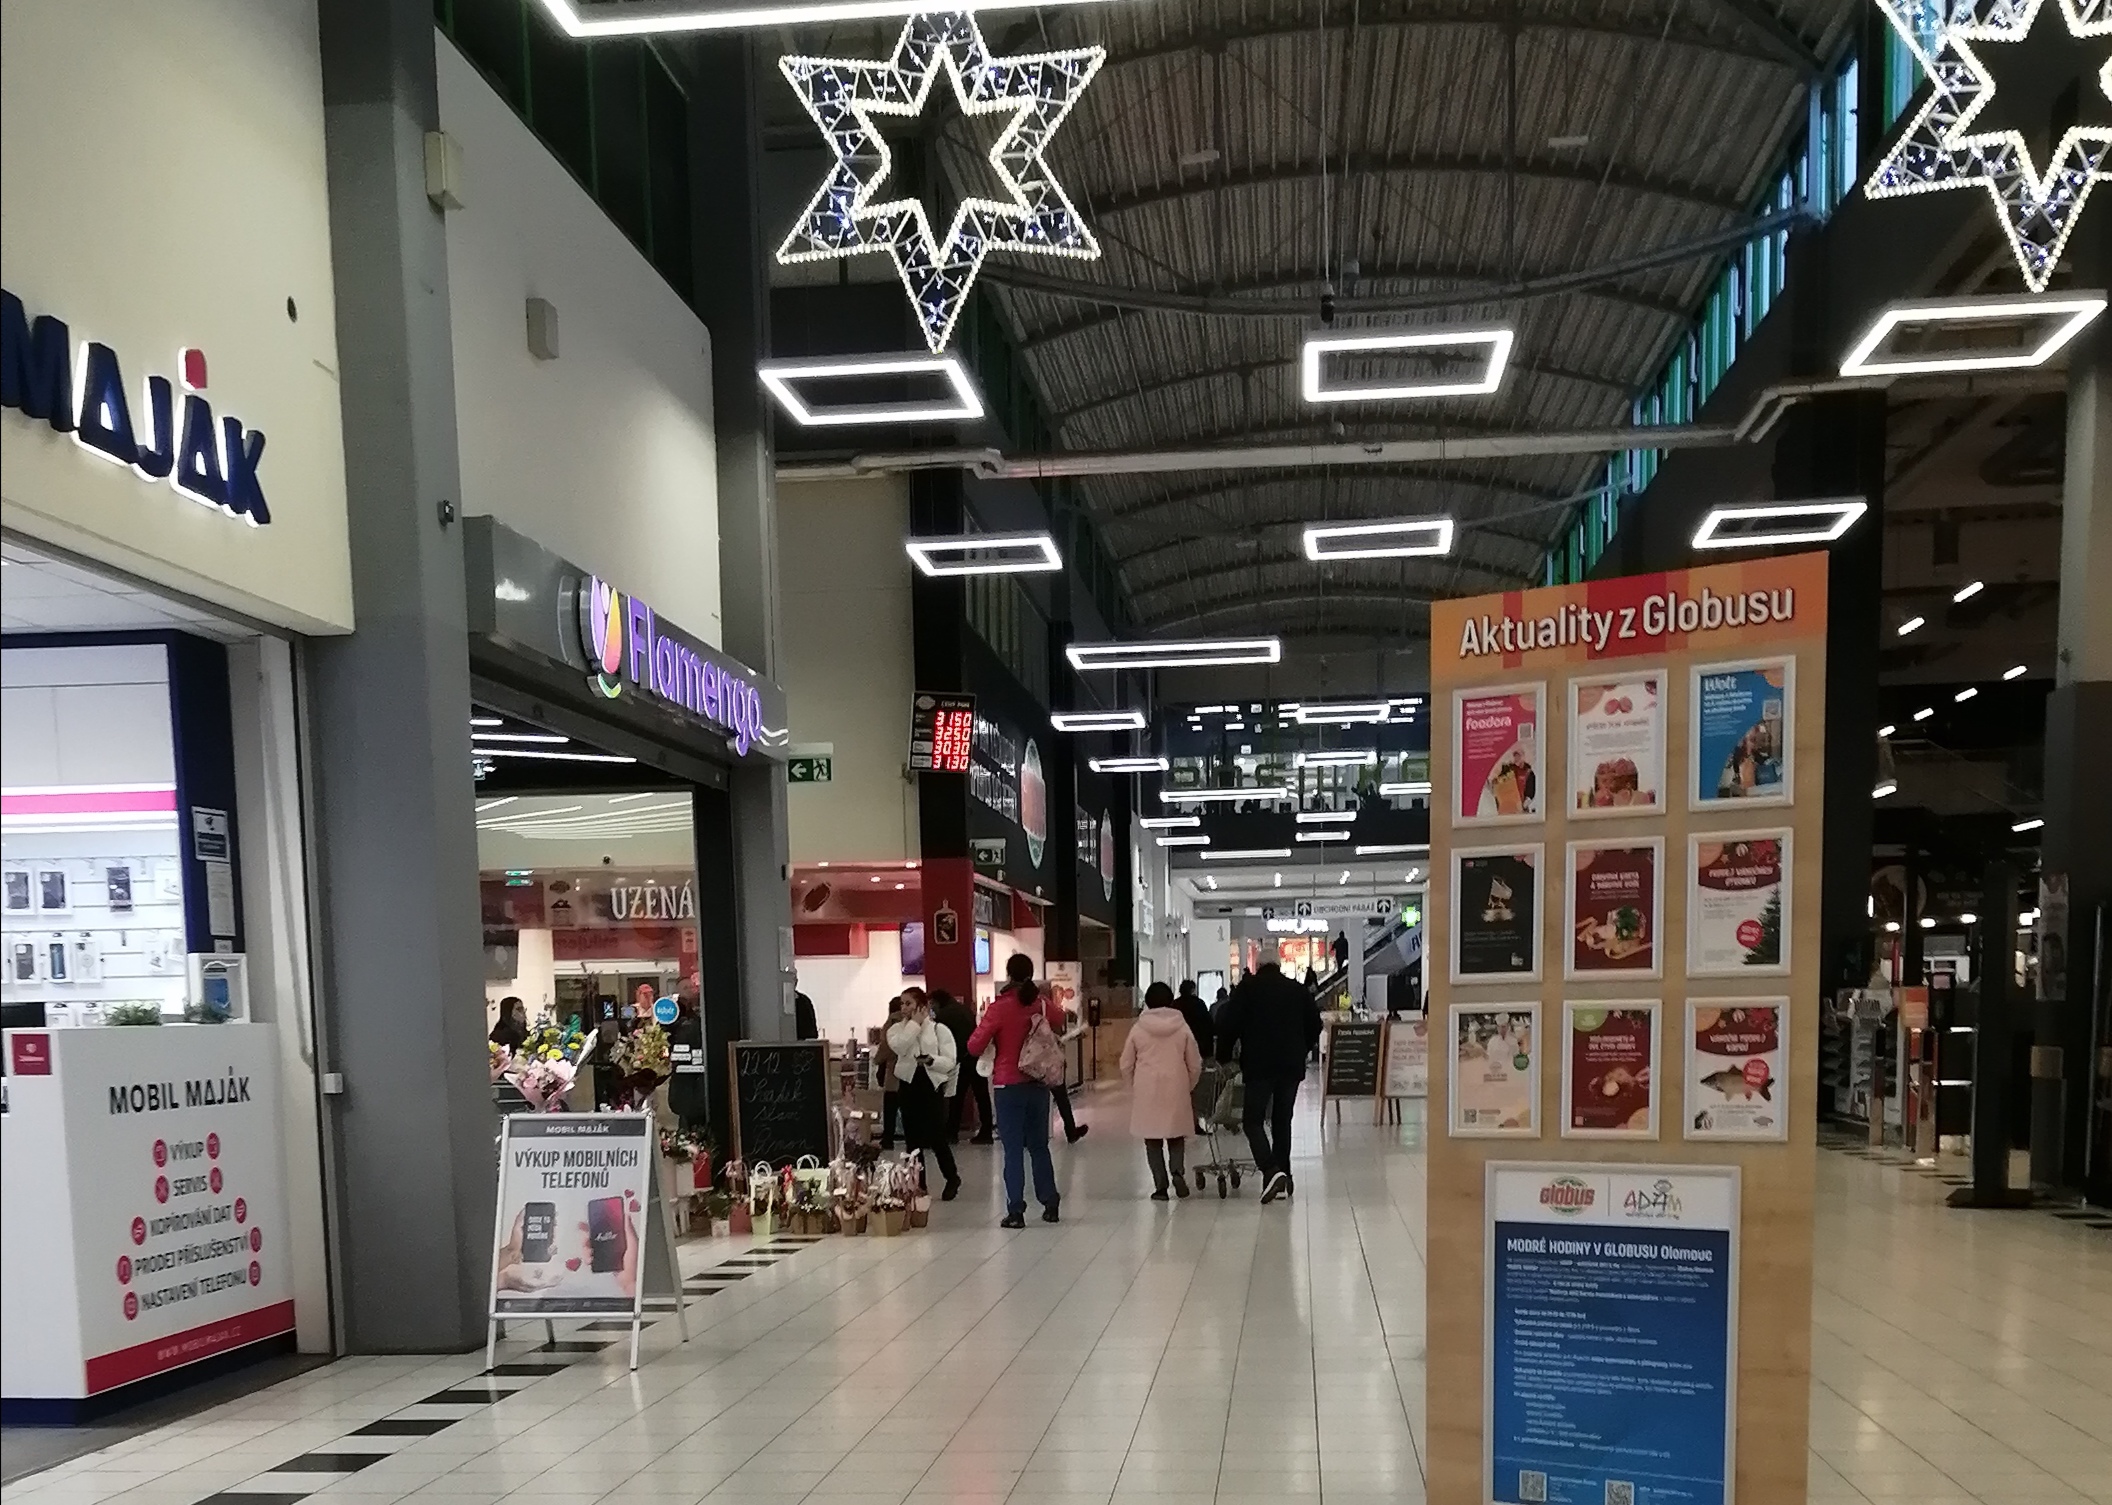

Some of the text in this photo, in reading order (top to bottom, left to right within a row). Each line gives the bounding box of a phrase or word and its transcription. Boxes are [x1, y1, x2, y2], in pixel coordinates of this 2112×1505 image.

[1459, 586, 1795, 658] Aktuality z Globusu
[626, 594, 763, 758] Flamengo
[1466, 715, 1512, 731] foodora
[109, 1066, 251, 1115] MOBIL MAJÁK
[546, 1125, 575, 1134] MOBIL
[515, 1146, 638, 1168] VÝKUP MOBILNÍCH
[541, 1167, 609, 1189] TELEFONŮ
[1506, 1236, 1713, 1262] MODRÉ HODINY V GLOBUSU Olomouc
[134, 1251, 175, 1277] PRODEJ
